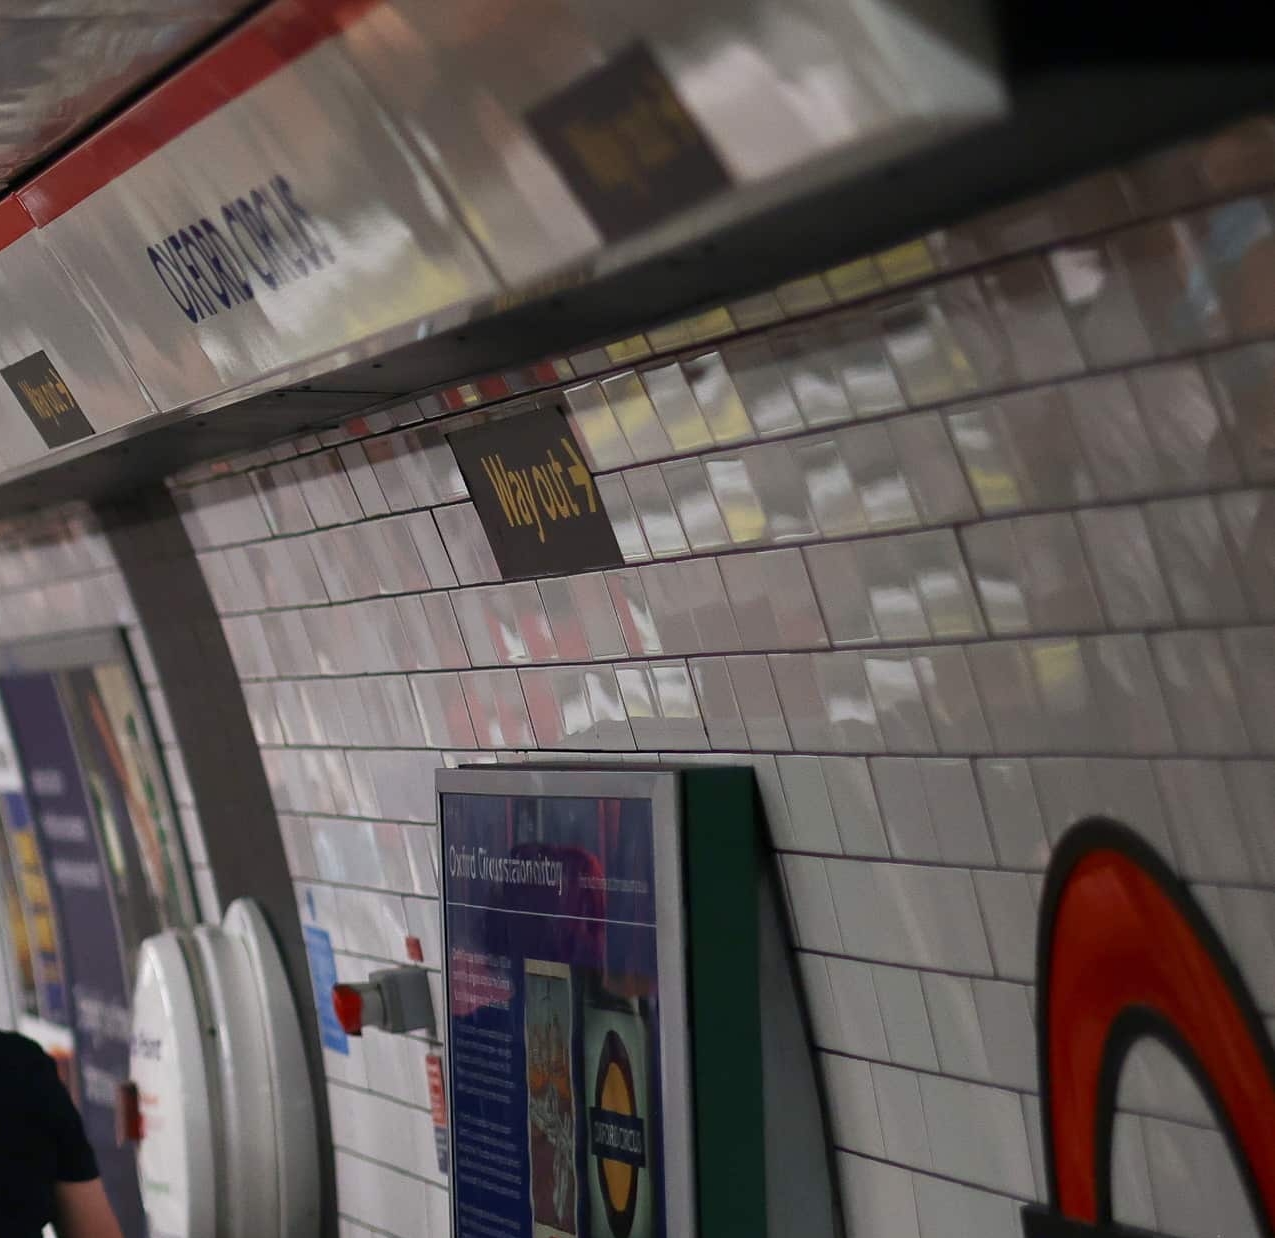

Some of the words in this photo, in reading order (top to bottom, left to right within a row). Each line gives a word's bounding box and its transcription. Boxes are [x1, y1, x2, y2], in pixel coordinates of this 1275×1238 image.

[147, 216, 254, 324] OXFORD
[480, 453, 546, 544] Way
[531, 448, 581, 521] out
[449, 845, 477, 880] Oxford
